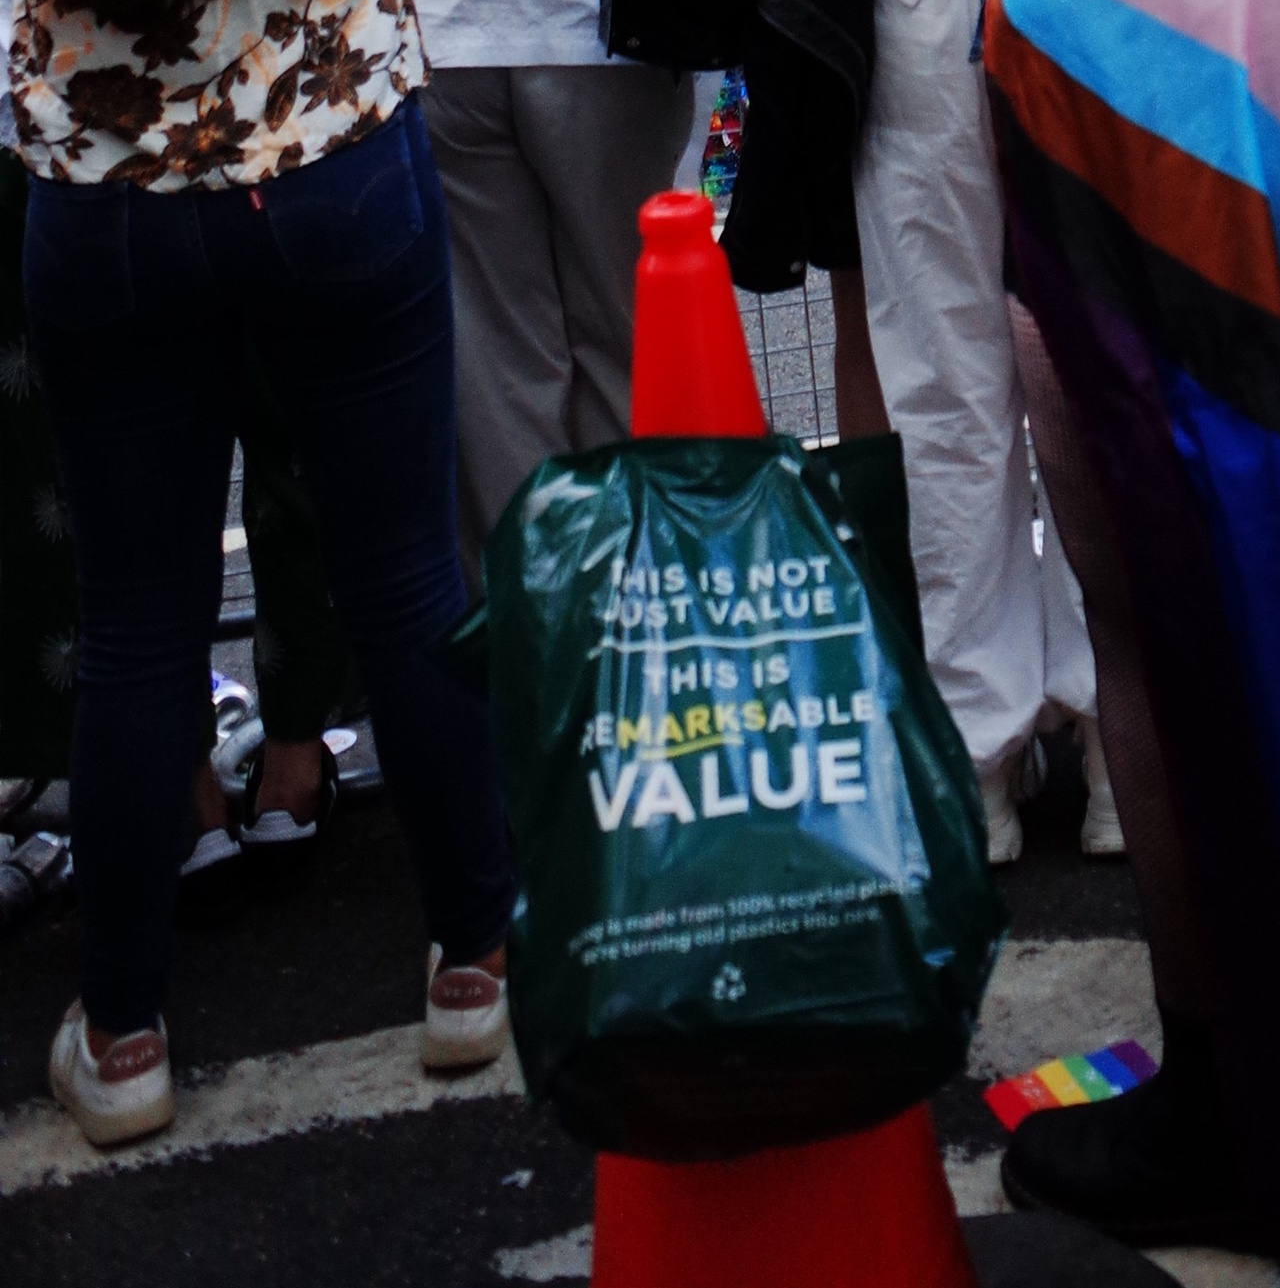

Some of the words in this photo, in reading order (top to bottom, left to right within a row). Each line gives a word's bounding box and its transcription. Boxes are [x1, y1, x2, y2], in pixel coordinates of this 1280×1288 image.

[612, 556, 687, 596] THIS
[700, 567, 735, 596] IS
[748, 555, 830, 592] NOT
[604, 593, 693, 628] JUST
[706, 586, 836, 626] VALUE
[645, 660, 738, 696] THIS
[753, 654, 791, 689] IS
[580, 689, 876, 757] REMARKSABLE
[588, 737, 868, 833] VALUE
